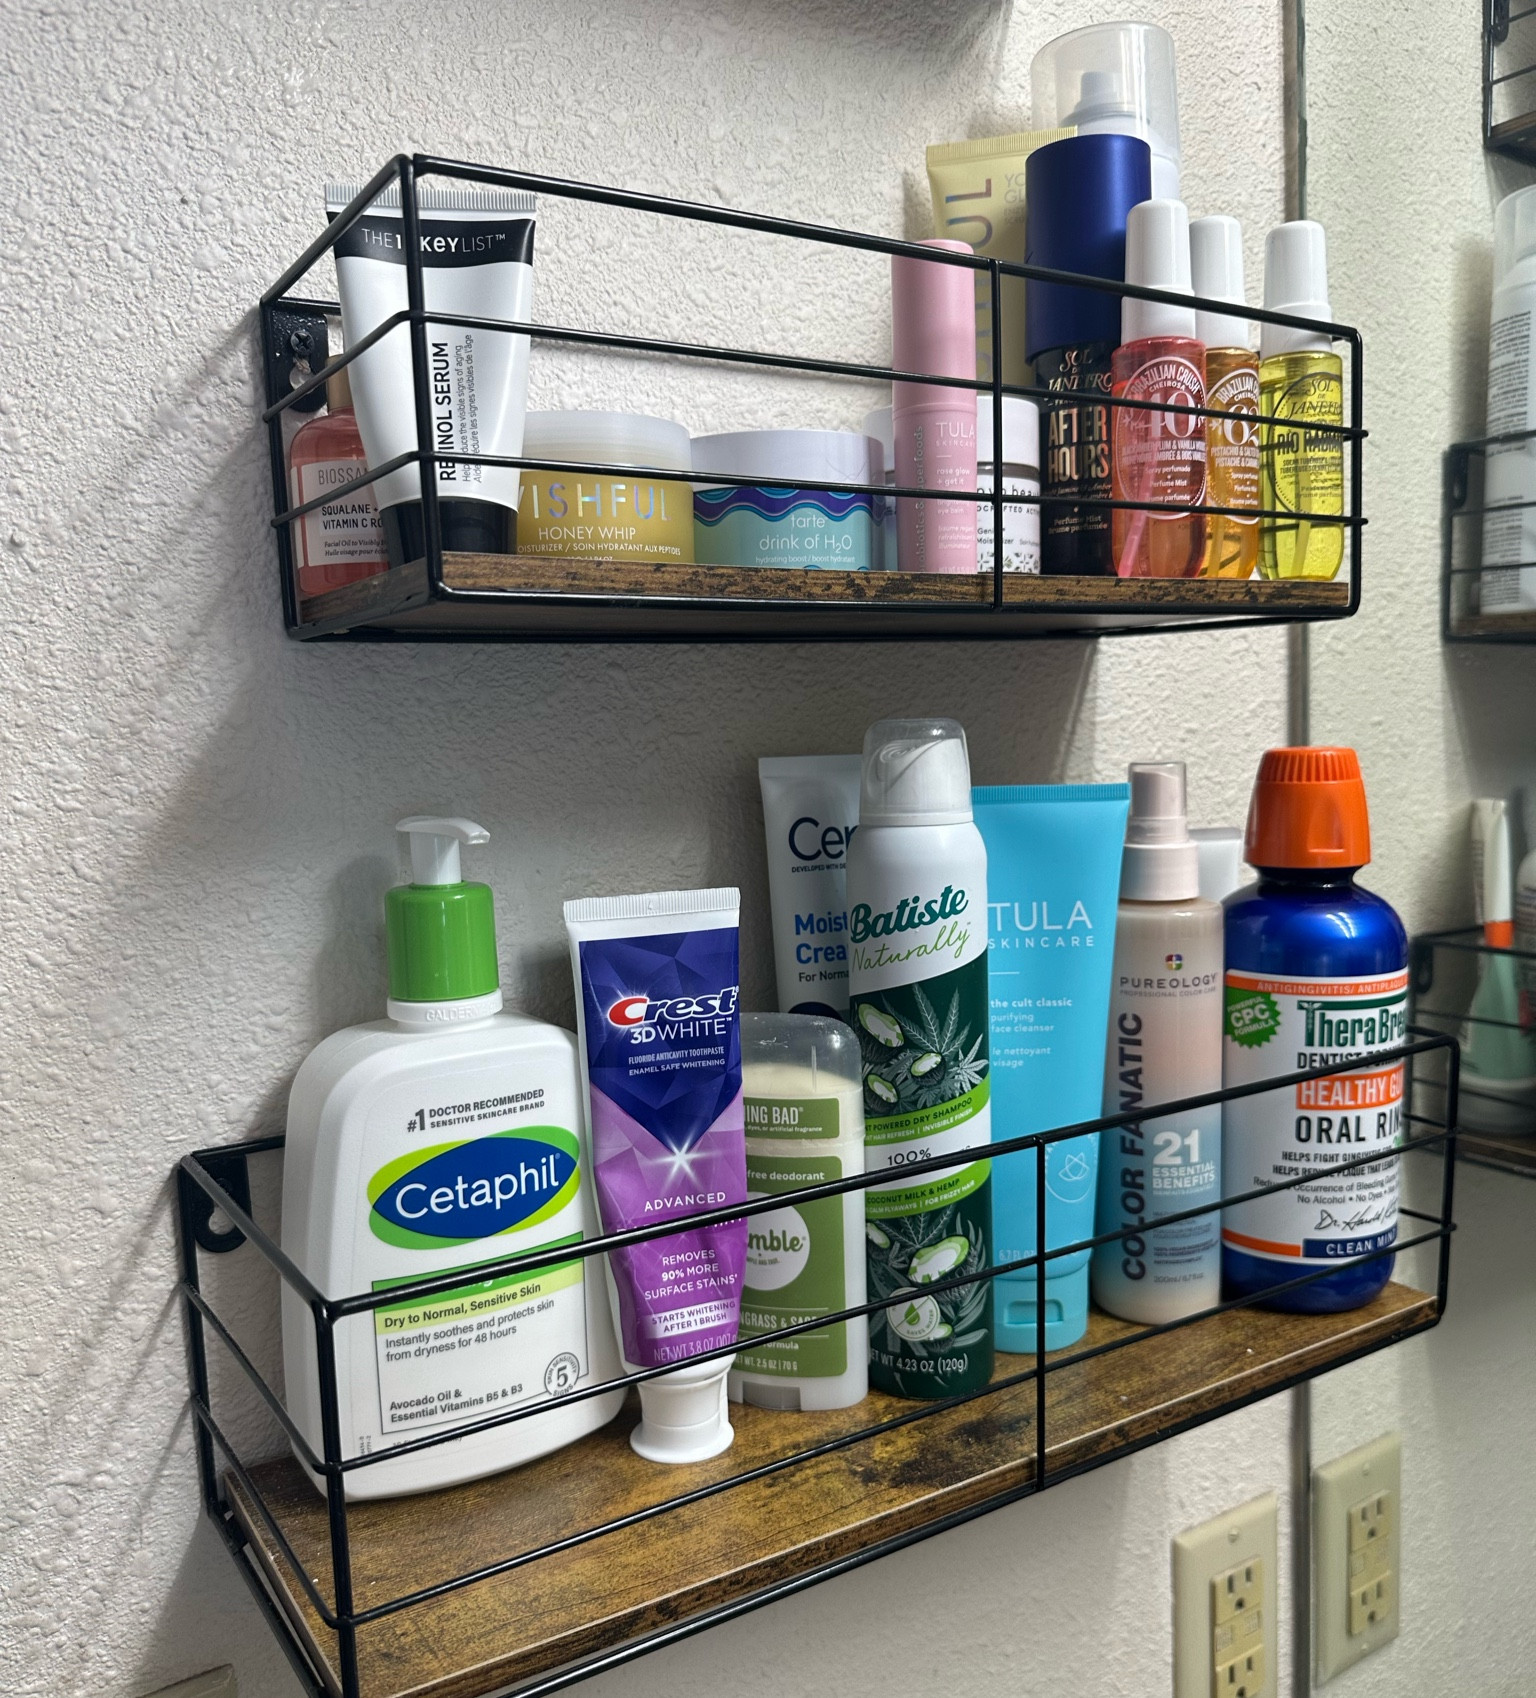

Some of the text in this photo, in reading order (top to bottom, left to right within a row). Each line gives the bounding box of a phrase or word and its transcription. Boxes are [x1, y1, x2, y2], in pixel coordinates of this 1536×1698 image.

[361, 228, 394, 248] THE
[455, 367, 462, 375] of
[1177, 367, 1200, 394] CRUSH
[456, 377, 466, 396] signs
[467, 354, 478, 417] signes visibles de
[1149, 380, 1186, 392] CHEIROSA
[432, 343, 456, 480] REINOL SERUM
[457, 398, 465, 416] visible
[936, 423, 975, 438] TULA
[1049, 406, 1107, 447] AFTER
[1048, 443, 1109, 483] HOURS
[322, 504, 370, 516] SQUALANE
[323, 519, 367, 530] VITAMIN C
[791, 514, 825, 528] tarte
[539, 526, 636, 541] HONEY WHIP
[760, 535, 799, 550] drink
[805, 535, 819, 549] of
[573, 543, 681, 555] SOIN HYDRATANT AUX PEPTIDES
[756, 556, 787, 564] hydrating
[788, 555, 807, 563] boost
[792, 864, 825, 873] DEVELOPED
[795, 911, 848, 935] Moist
[851, 885, 969, 944] Batiste
[988, 901, 1093, 931] TULA
[852, 920, 970, 972] Naturally
[988, 936, 1094, 949] SKINCARE
[796, 942, 849, 964] Crea
[799, 972, 817, 982] For
[1121, 972, 1216, 988] PUREOLOGY
[608, 987, 737, 1027] Crest
[990, 999, 1072, 1008] the cult classic
[991, 1013, 1034, 1023] purifying
[1230, 1003, 1270, 1028] CPC
[991, 1024, 1054, 1033] face cleanser
[1234, 1018, 1275, 1036] FORMULA
[629, 1046, 724, 1065] FLUORIDE ANTICAVITY TOOTHPASTE
[1004, 1047, 1050, 1056] nettoyant
[629, 1058, 725, 1076] ENAMEL SAFE WHITENING
[993, 1058, 1024, 1068] visage
[1118, 1012, 1143, 1156] FANATIC
[1302, 1078, 1388, 1106] HEALTHY
[407, 1089, 544, 1132] #1 DOCTOR RECOMMENDED
[430, 1101, 545, 1128] SENSITIVE SKINCARE BRAND
[744, 1105, 768, 1124] ING
[873, 1097, 972, 1130] POWERED DRY SHAMPOO
[887, 1108, 973, 1139] REFRESH INVISIBLE FINISH
[1295, 1115, 1365, 1143] ORAL
[1153, 1128, 1199, 1165] 21
[888, 1148, 931, 1166] 100%
[1282, 1151, 1310, 1162] HELPS
[1314, 1153, 1339, 1163] FIGHT
[770, 1171, 825, 1180] deodorant
[1153, 1161, 1215, 1177] ESSENTIAL
[1273, 1165, 1299, 1176] HELPS
[395, 1154, 559, 1219] Cetaphil
[905, 1191, 926, 1200] MILK
[937, 1179, 960, 1190] HEMP
[1153, 1171, 1215, 1189] BENEFITS
[1346, 1183, 1354, 1191] of
[644, 1191, 726, 1212] ADVANCED
[925, 1180, 975, 1205] FOR FRIZZY HAIR
[1297, 1195, 1310, 1203] No
[1313, 1195, 1345, 1204] Alcohol
[748, 1229, 803, 1252] mble
[1326, 1240, 1372, 1255] CLEAN
[662, 1250, 716, 1266] REMOVES
[661, 1263, 719, 1281] 90% MORE
[645, 1284, 694, 1301] SURFACE
[384, 1282, 541, 1329] Dry to Normal, Sensitive Skin
[652, 1301, 736, 1325] STARTS WHITENING
[386, 1299, 554, 1349] Instantly soothes and protects skin
[664, 1313, 727, 1333] AFTER BRUSH
[740, 1312, 777, 1328] NGRASS
[387, 1325, 517, 1362] from dryness for 48 hours
[654, 1341, 702, 1361] NET WT 3.8
[881, 1353, 968, 1374] WT 4.23 OZ (120g)
[557, 1365, 568, 1387] 5
[390, 1389, 462, 1411] Avocado Oil &
[391, 1383, 523, 1423] Essential Vitamins B5 & B3
